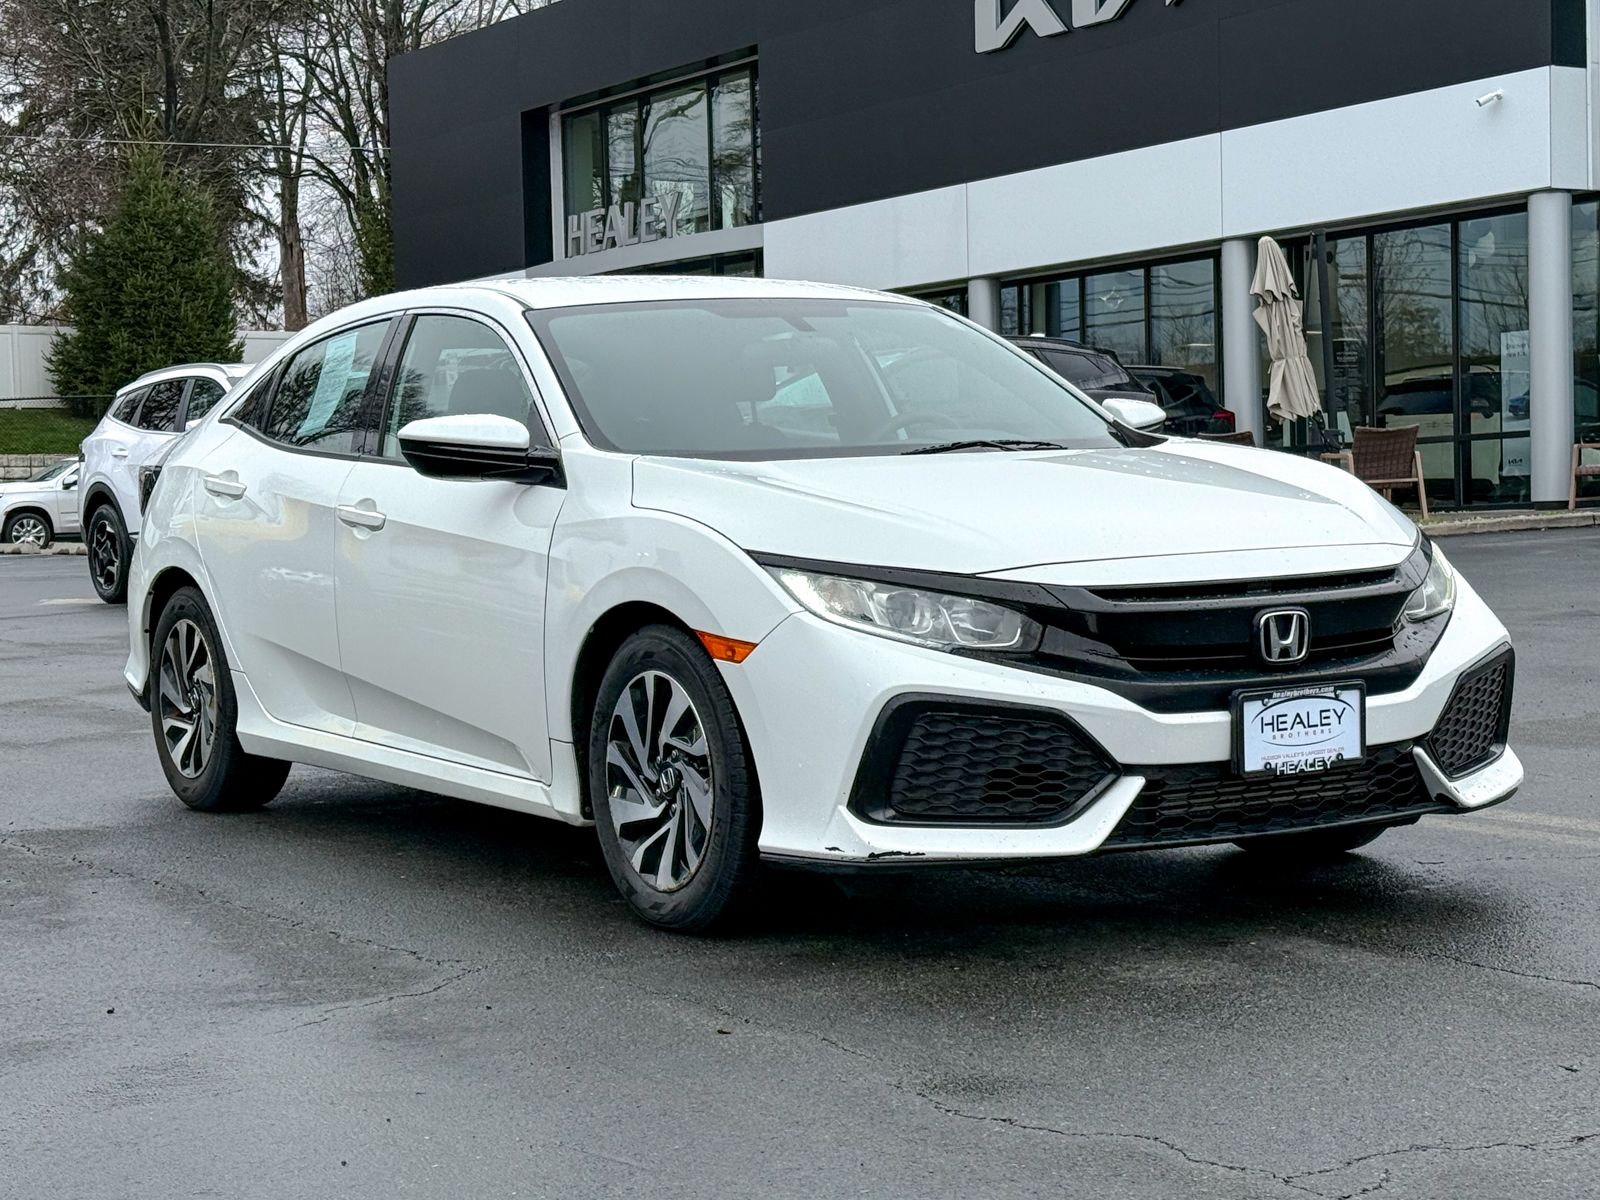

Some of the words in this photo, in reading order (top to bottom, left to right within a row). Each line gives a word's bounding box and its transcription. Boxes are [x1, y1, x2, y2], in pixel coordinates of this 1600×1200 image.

[568, 192, 683, 258] HEALEY
[1261, 707, 1346, 734] HEALEY
[1272, 729, 1332, 740] BROTHERS
[1276, 756, 1332, 775] HEALEY
